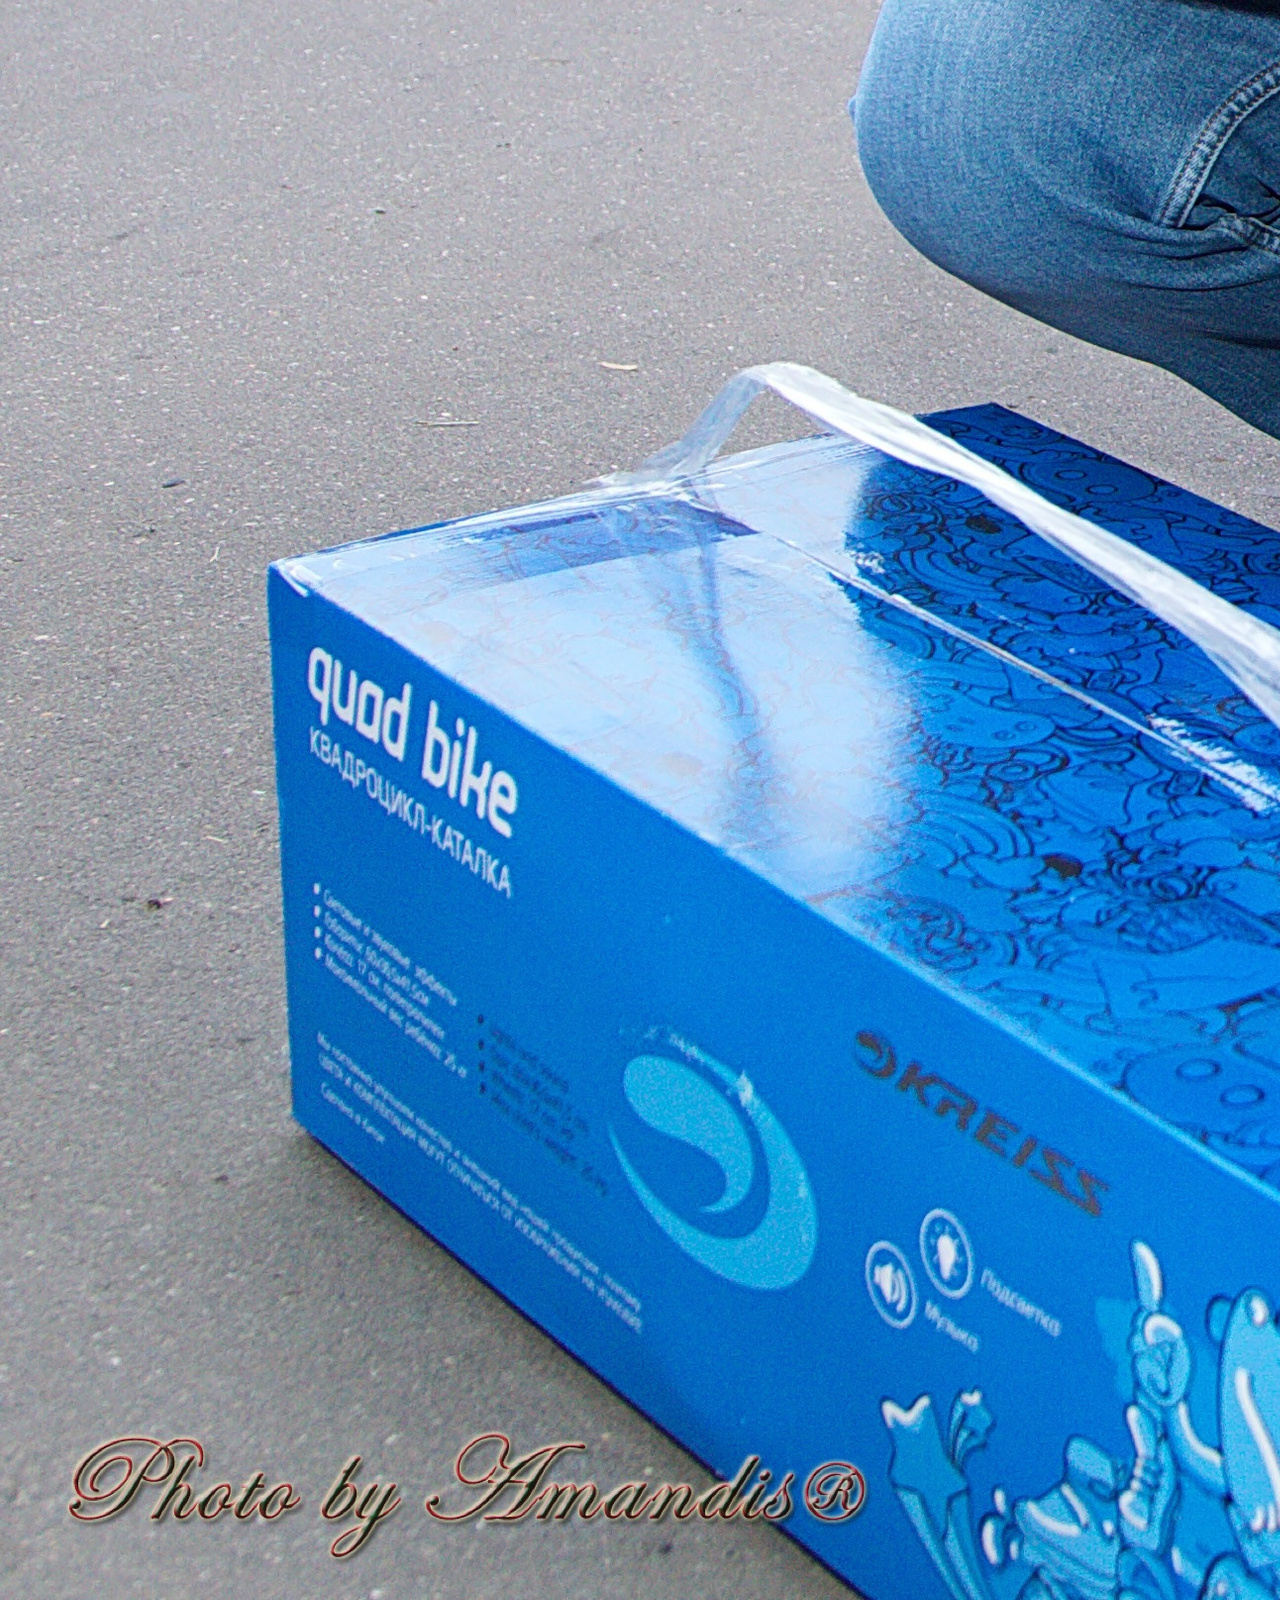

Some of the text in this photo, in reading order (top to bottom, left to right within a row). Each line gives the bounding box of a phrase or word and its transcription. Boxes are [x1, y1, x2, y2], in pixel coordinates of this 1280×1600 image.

[307, 646, 519, 839] quad bike
[309, 725, 513, 900] КВАДРОЦИКЛ-КАТАЛКА
